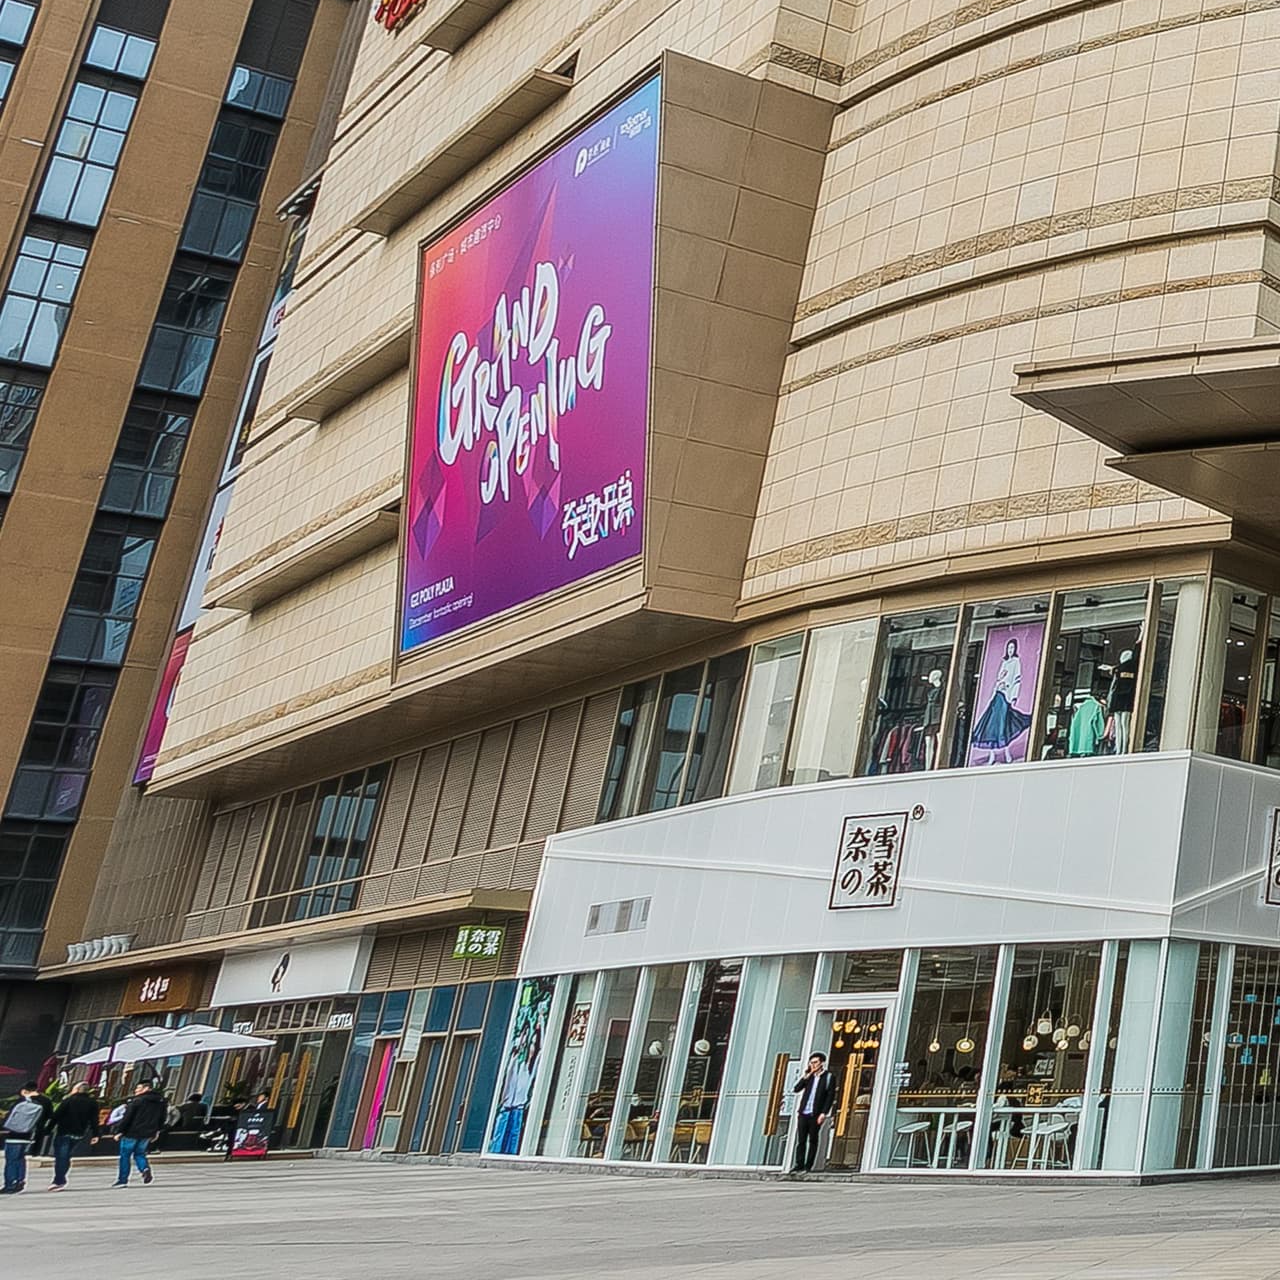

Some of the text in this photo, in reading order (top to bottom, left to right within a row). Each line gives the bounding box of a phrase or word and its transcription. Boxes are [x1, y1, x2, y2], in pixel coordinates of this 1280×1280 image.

[438, 261, 560, 467] GRAND
[480, 303, 612, 506] OPENING
[420, 585, 434, 604] POLY
[436, 577, 455, 597] PLAZA
[843, 824, 898, 863] 奈雪
[840, 860, 894, 897] の茶
